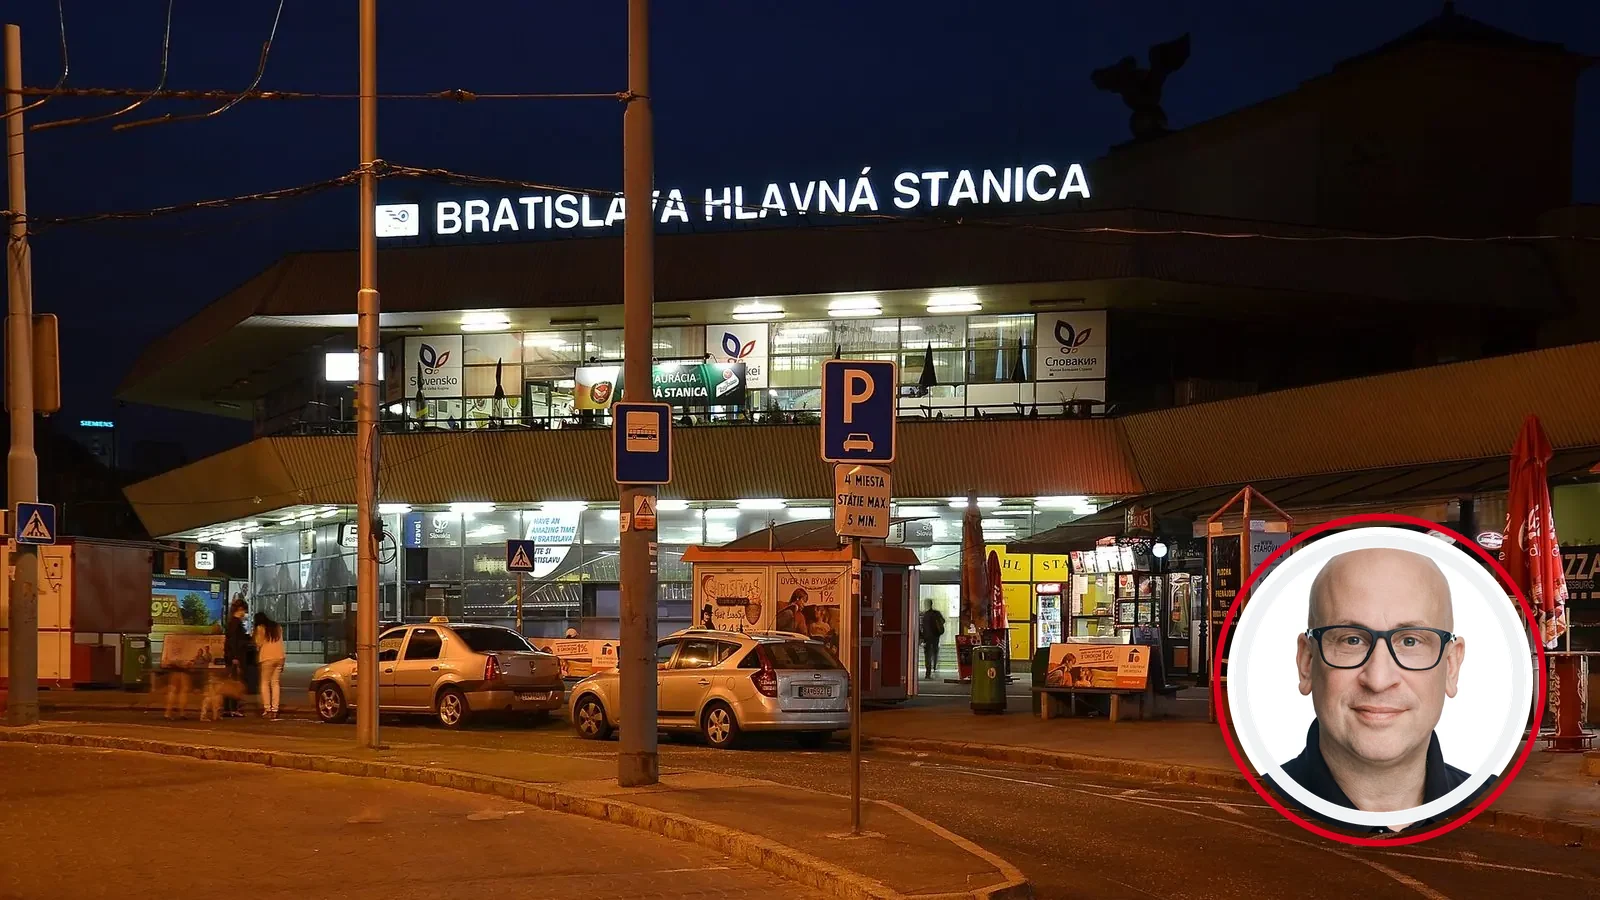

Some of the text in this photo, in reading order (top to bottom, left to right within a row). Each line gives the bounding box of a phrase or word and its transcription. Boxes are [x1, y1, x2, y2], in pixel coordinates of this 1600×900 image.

[704, 166, 879, 222] HLAVNÁ
[893, 163, 1091, 210] STANICA
[1045, 356, 1097, 367] Словакия
[410, 374, 458, 386] Sovensko
[652, 372, 696, 384] AURÁCIA
[665, 386, 708, 398] STANICA
[844, 369, 875, 423] P
[845, 473, 885, 488] 4 MIESTA
[838, 492, 888, 509] STÁTIE MAX.
[847, 514, 877, 528] 5 MIN.
[532, 526, 576, 534] AMAZING TIME
[534, 556, 561, 564] ATISLAVU
[1216, 568, 1232, 576] PLOCHA
[1564, 553, 1600, 580] ZZA
[780, 576, 838, 585] ÚVER NA BÝVANIE
[1567, 580, 1596, 590] SSBURG
[819, 591, 834, 603] 1%
[1102, 649, 1113, 661] 1%
